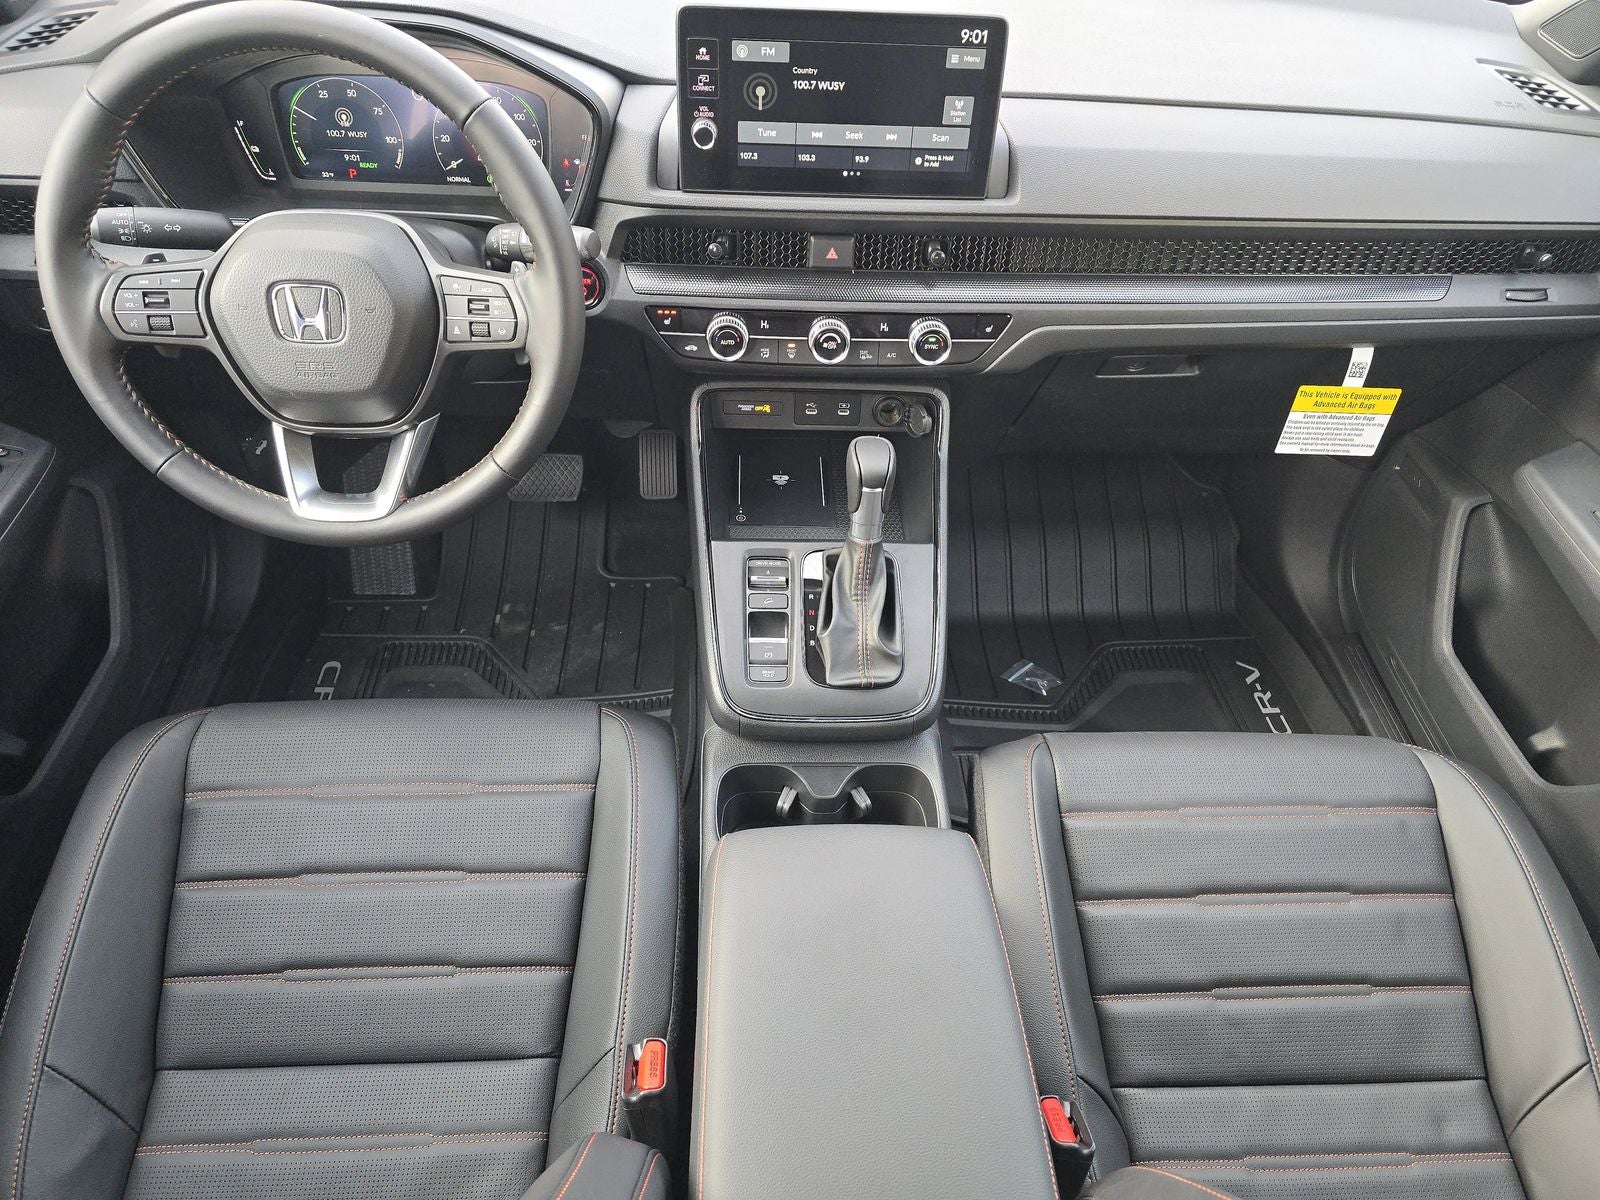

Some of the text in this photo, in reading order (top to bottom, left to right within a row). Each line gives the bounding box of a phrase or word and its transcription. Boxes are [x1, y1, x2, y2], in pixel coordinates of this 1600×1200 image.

[961, 28, 988, 44] 9:01
[760, 46, 776, 56] FM
[792, 66, 818, 76] Country
[792, 80, 845, 91] 100.7 WUSY
[757, 128, 776, 138] Tune
[845, 131, 863, 140] Seek
[932, 134, 950, 142] Scan
[740, 152, 758, 160] 107.3
[798, 154, 816, 162] 103.3
[855, 155, 869, 163] 93.9
[349, 169, 357, 178] P
[1316, 391, 1340, 399] Vehicle
[1350, 392, 1382, 402] Equipped
[1359, 402, 1376, 410] Bags
[1236, 660, 1292, 734] CR-V
